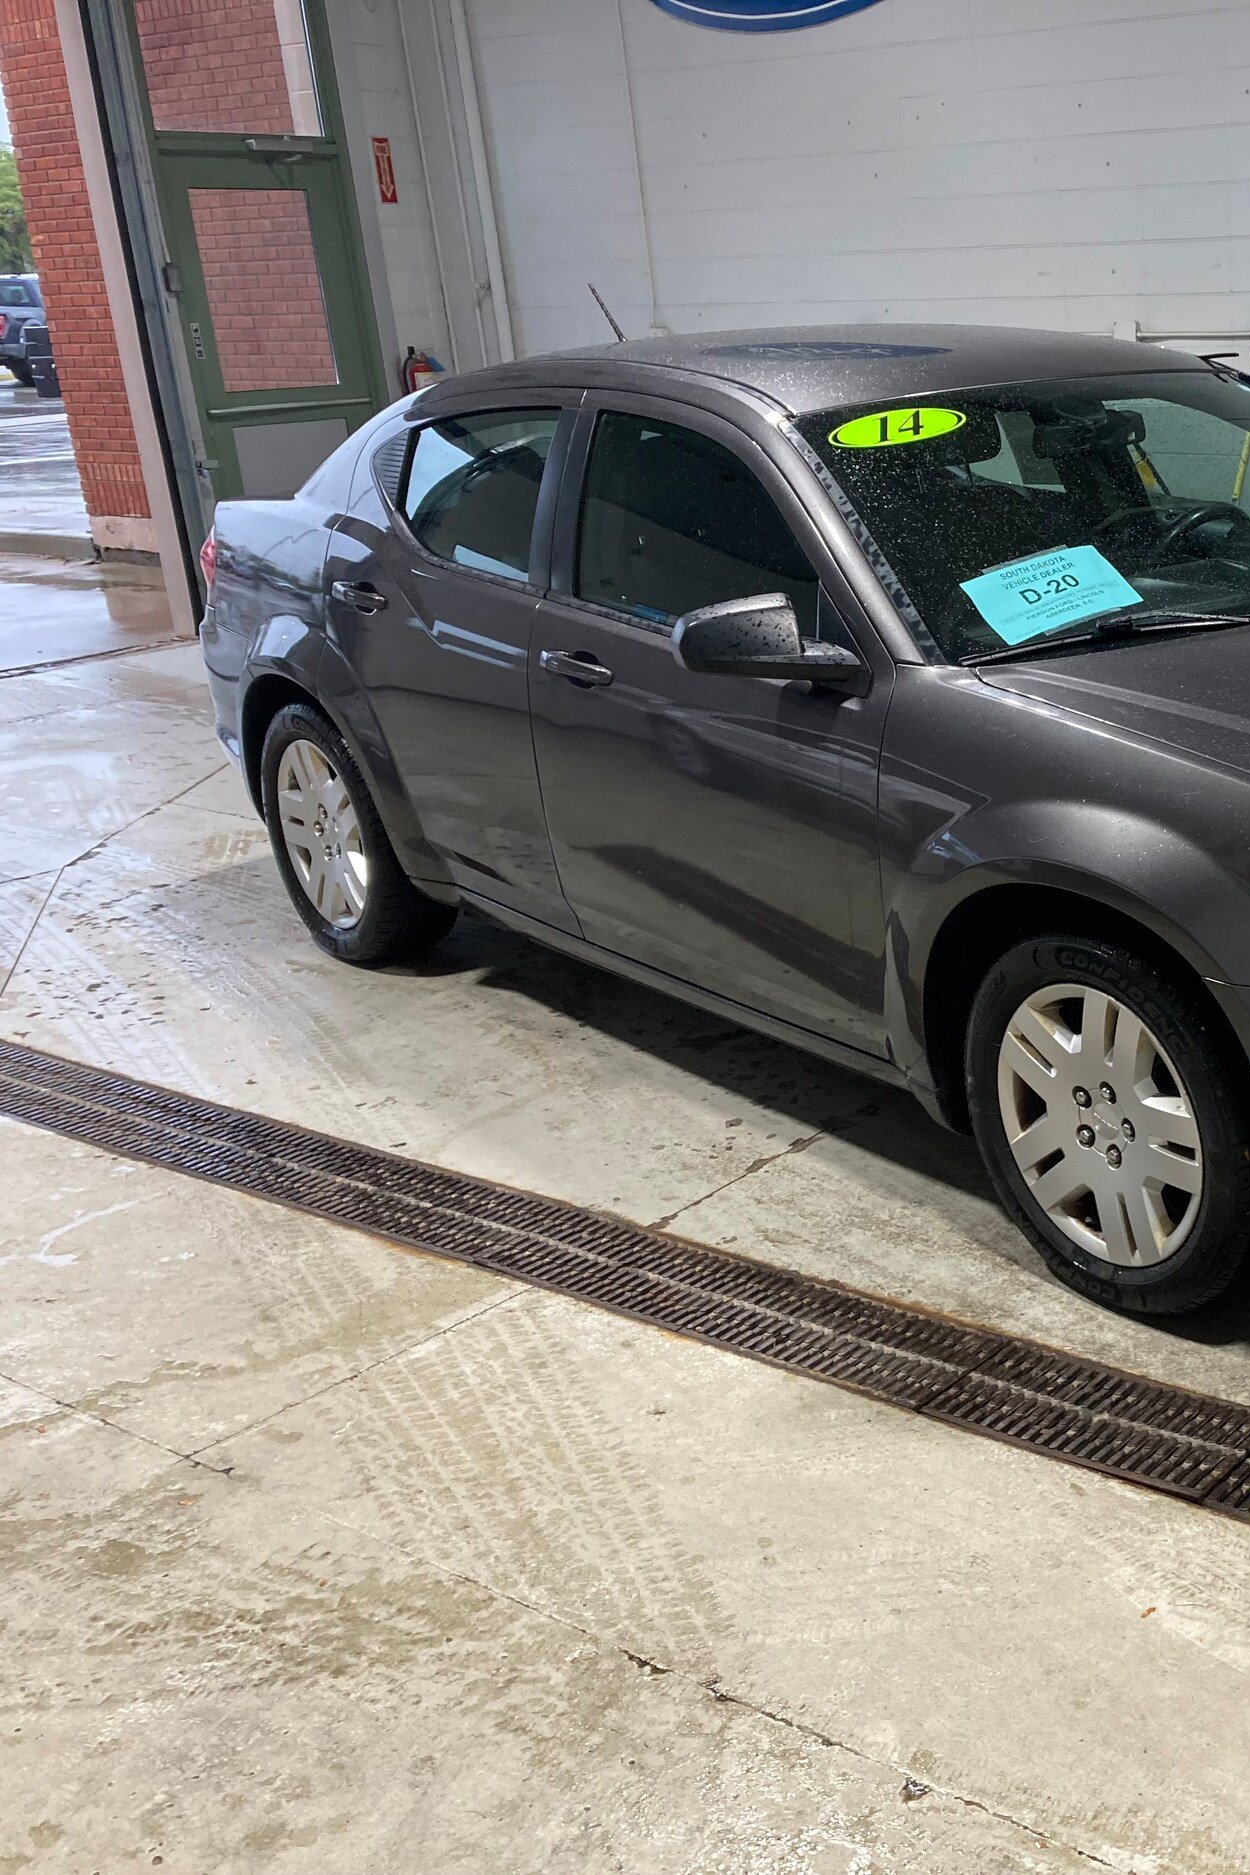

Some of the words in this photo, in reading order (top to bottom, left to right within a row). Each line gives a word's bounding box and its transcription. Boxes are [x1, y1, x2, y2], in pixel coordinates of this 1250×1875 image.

[873, 409, 925, 443] 14
[1000, 567, 1030, 581] SOUTH
[1031, 556, 1067, 571] DAKOTA
[1001, 574, 1041, 591] VEHICLE
[1040, 562, 1076, 578] DEALER
[1019, 574, 1080, 605] D-20
